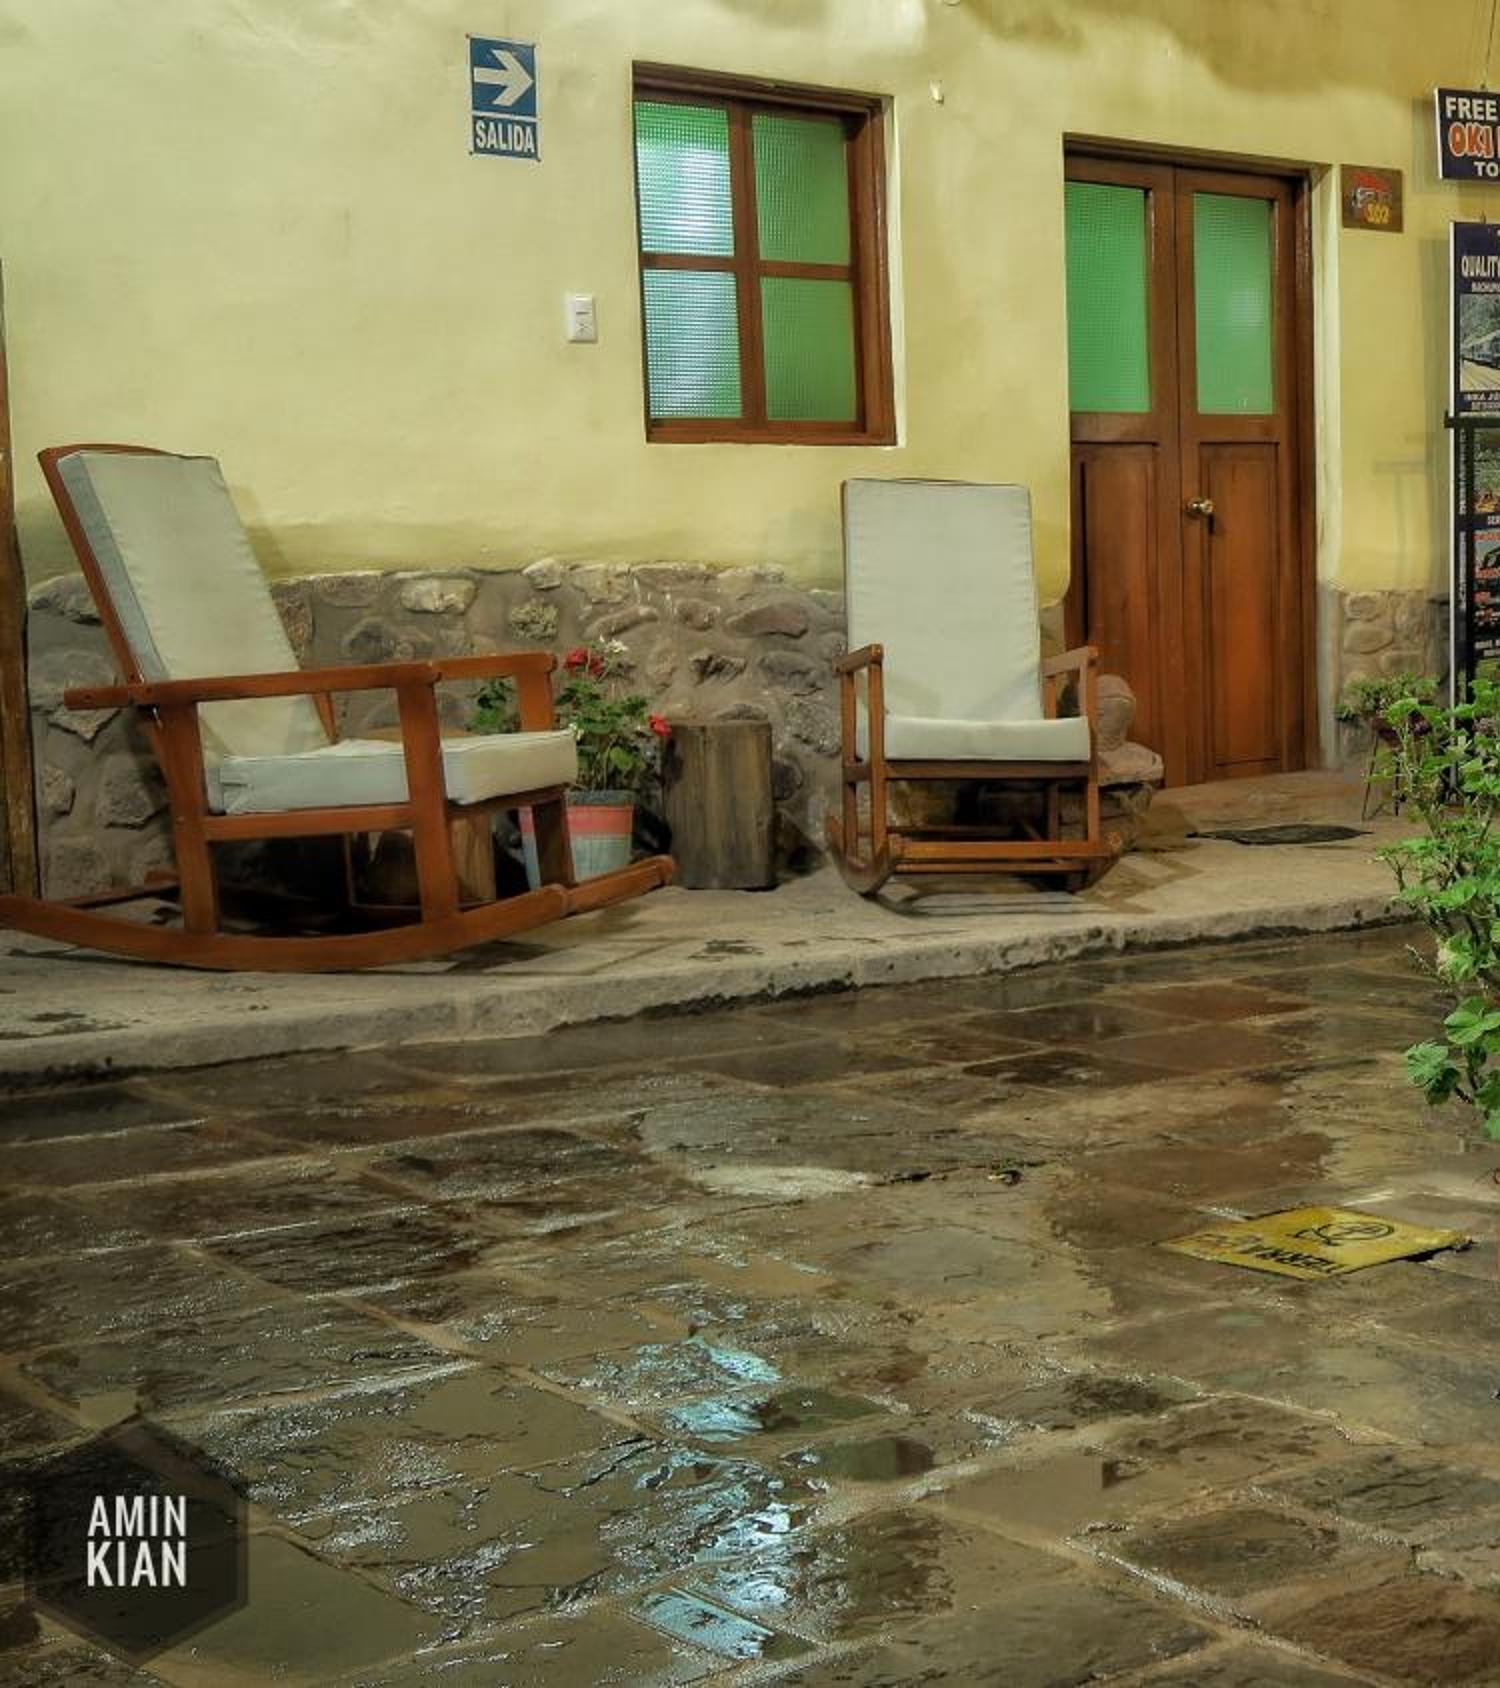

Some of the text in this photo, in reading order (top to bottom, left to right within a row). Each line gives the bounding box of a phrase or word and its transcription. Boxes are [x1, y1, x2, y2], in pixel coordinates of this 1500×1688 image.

[1445, 96, 1498, 120] FREE
[475, 119, 535, 153] SALIDA
[1448, 122, 1493, 158] OKI
